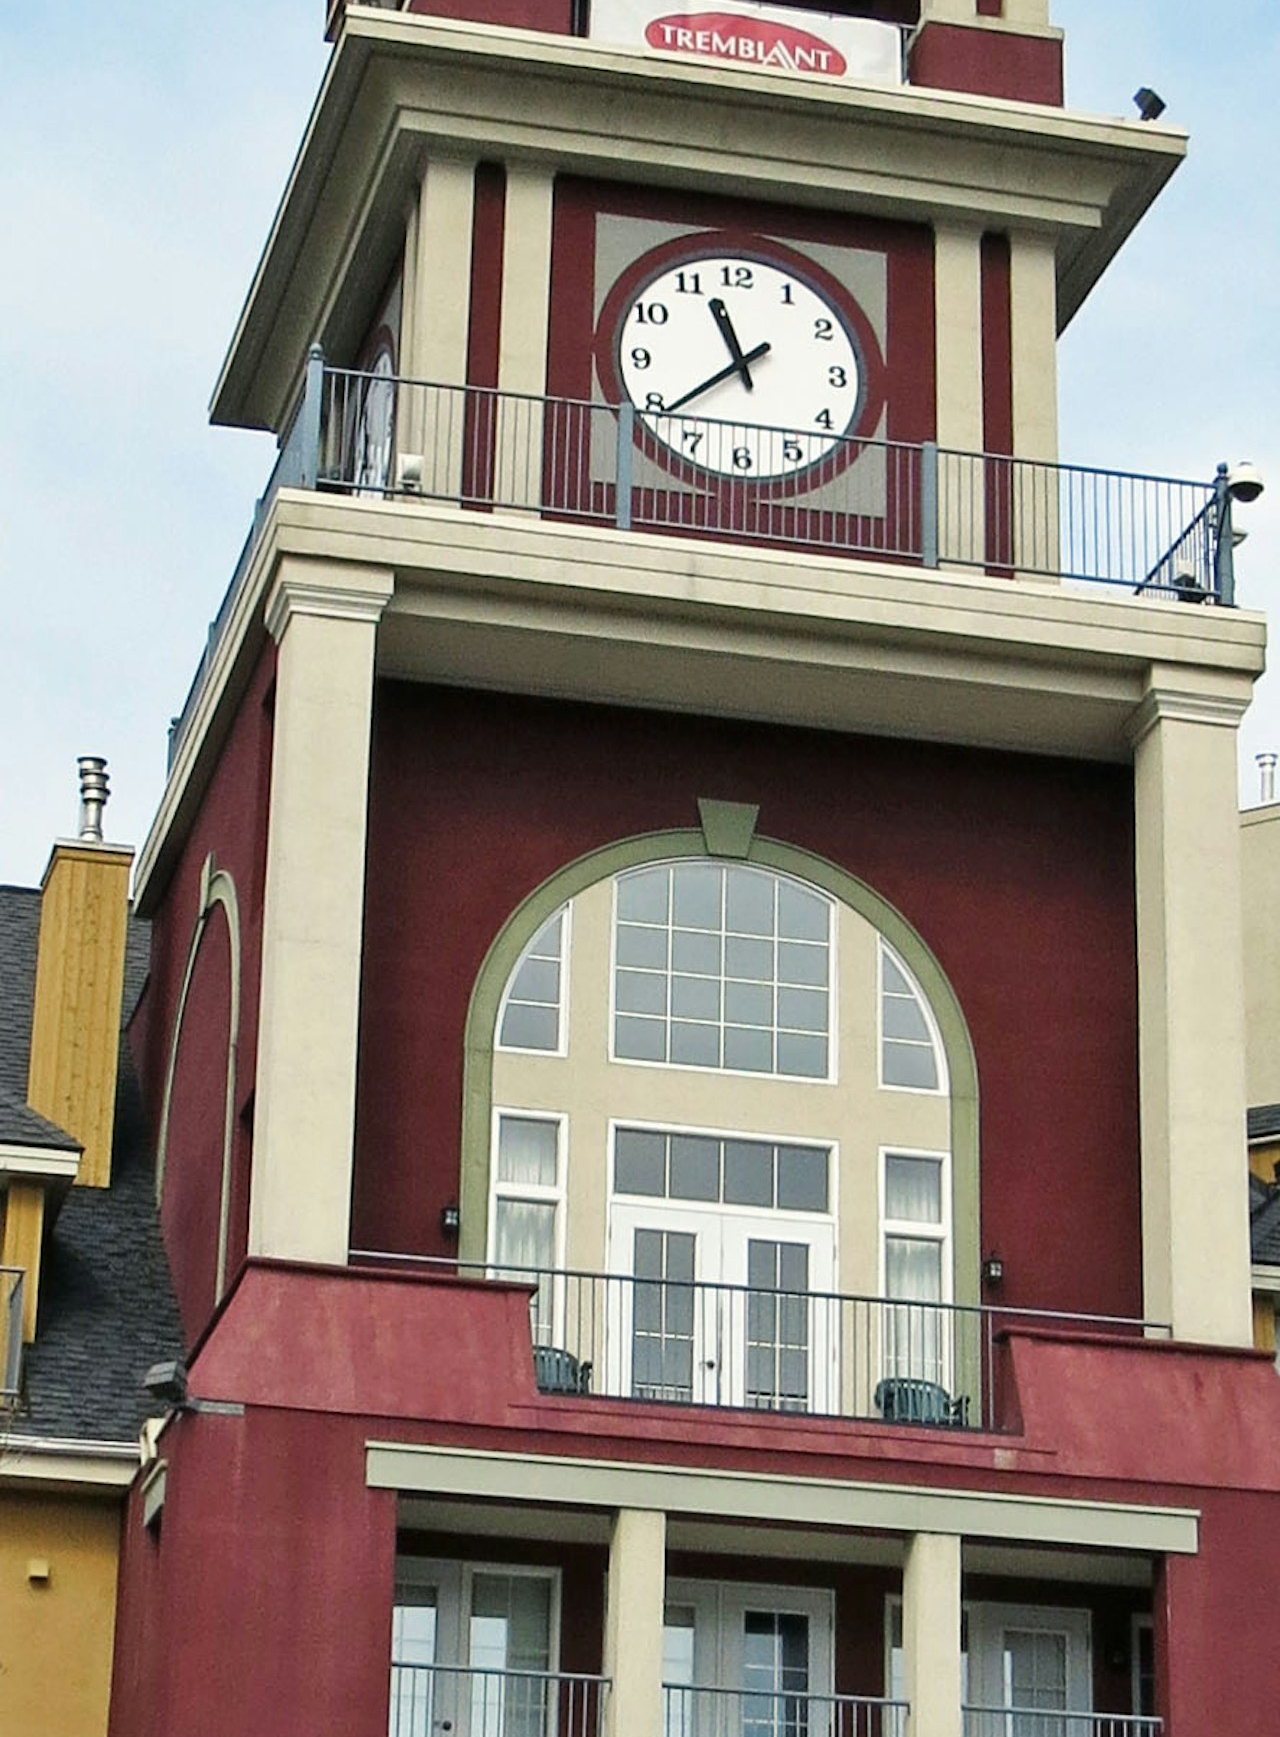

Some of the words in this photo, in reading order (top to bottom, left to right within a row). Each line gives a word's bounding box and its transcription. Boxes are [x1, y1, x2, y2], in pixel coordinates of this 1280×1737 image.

[658, 23, 833, 70] TREMBLANT
[675, 272, 704, 295] 11
[721, 266, 754, 289] 12
[781, 284, 796, 305] 1
[634, 302, 669, 325] 10
[814, 319, 834, 341] 2
[631, 348, 651, 369] 9
[829, 366, 847, 388] 3
[645, 392, 665, 417] 8
[815, 408, 834, 430] 4
[683, 431, 704, 454] 7
[783, 440, 803, 462] 5
[732, 447, 753, 469] 6
